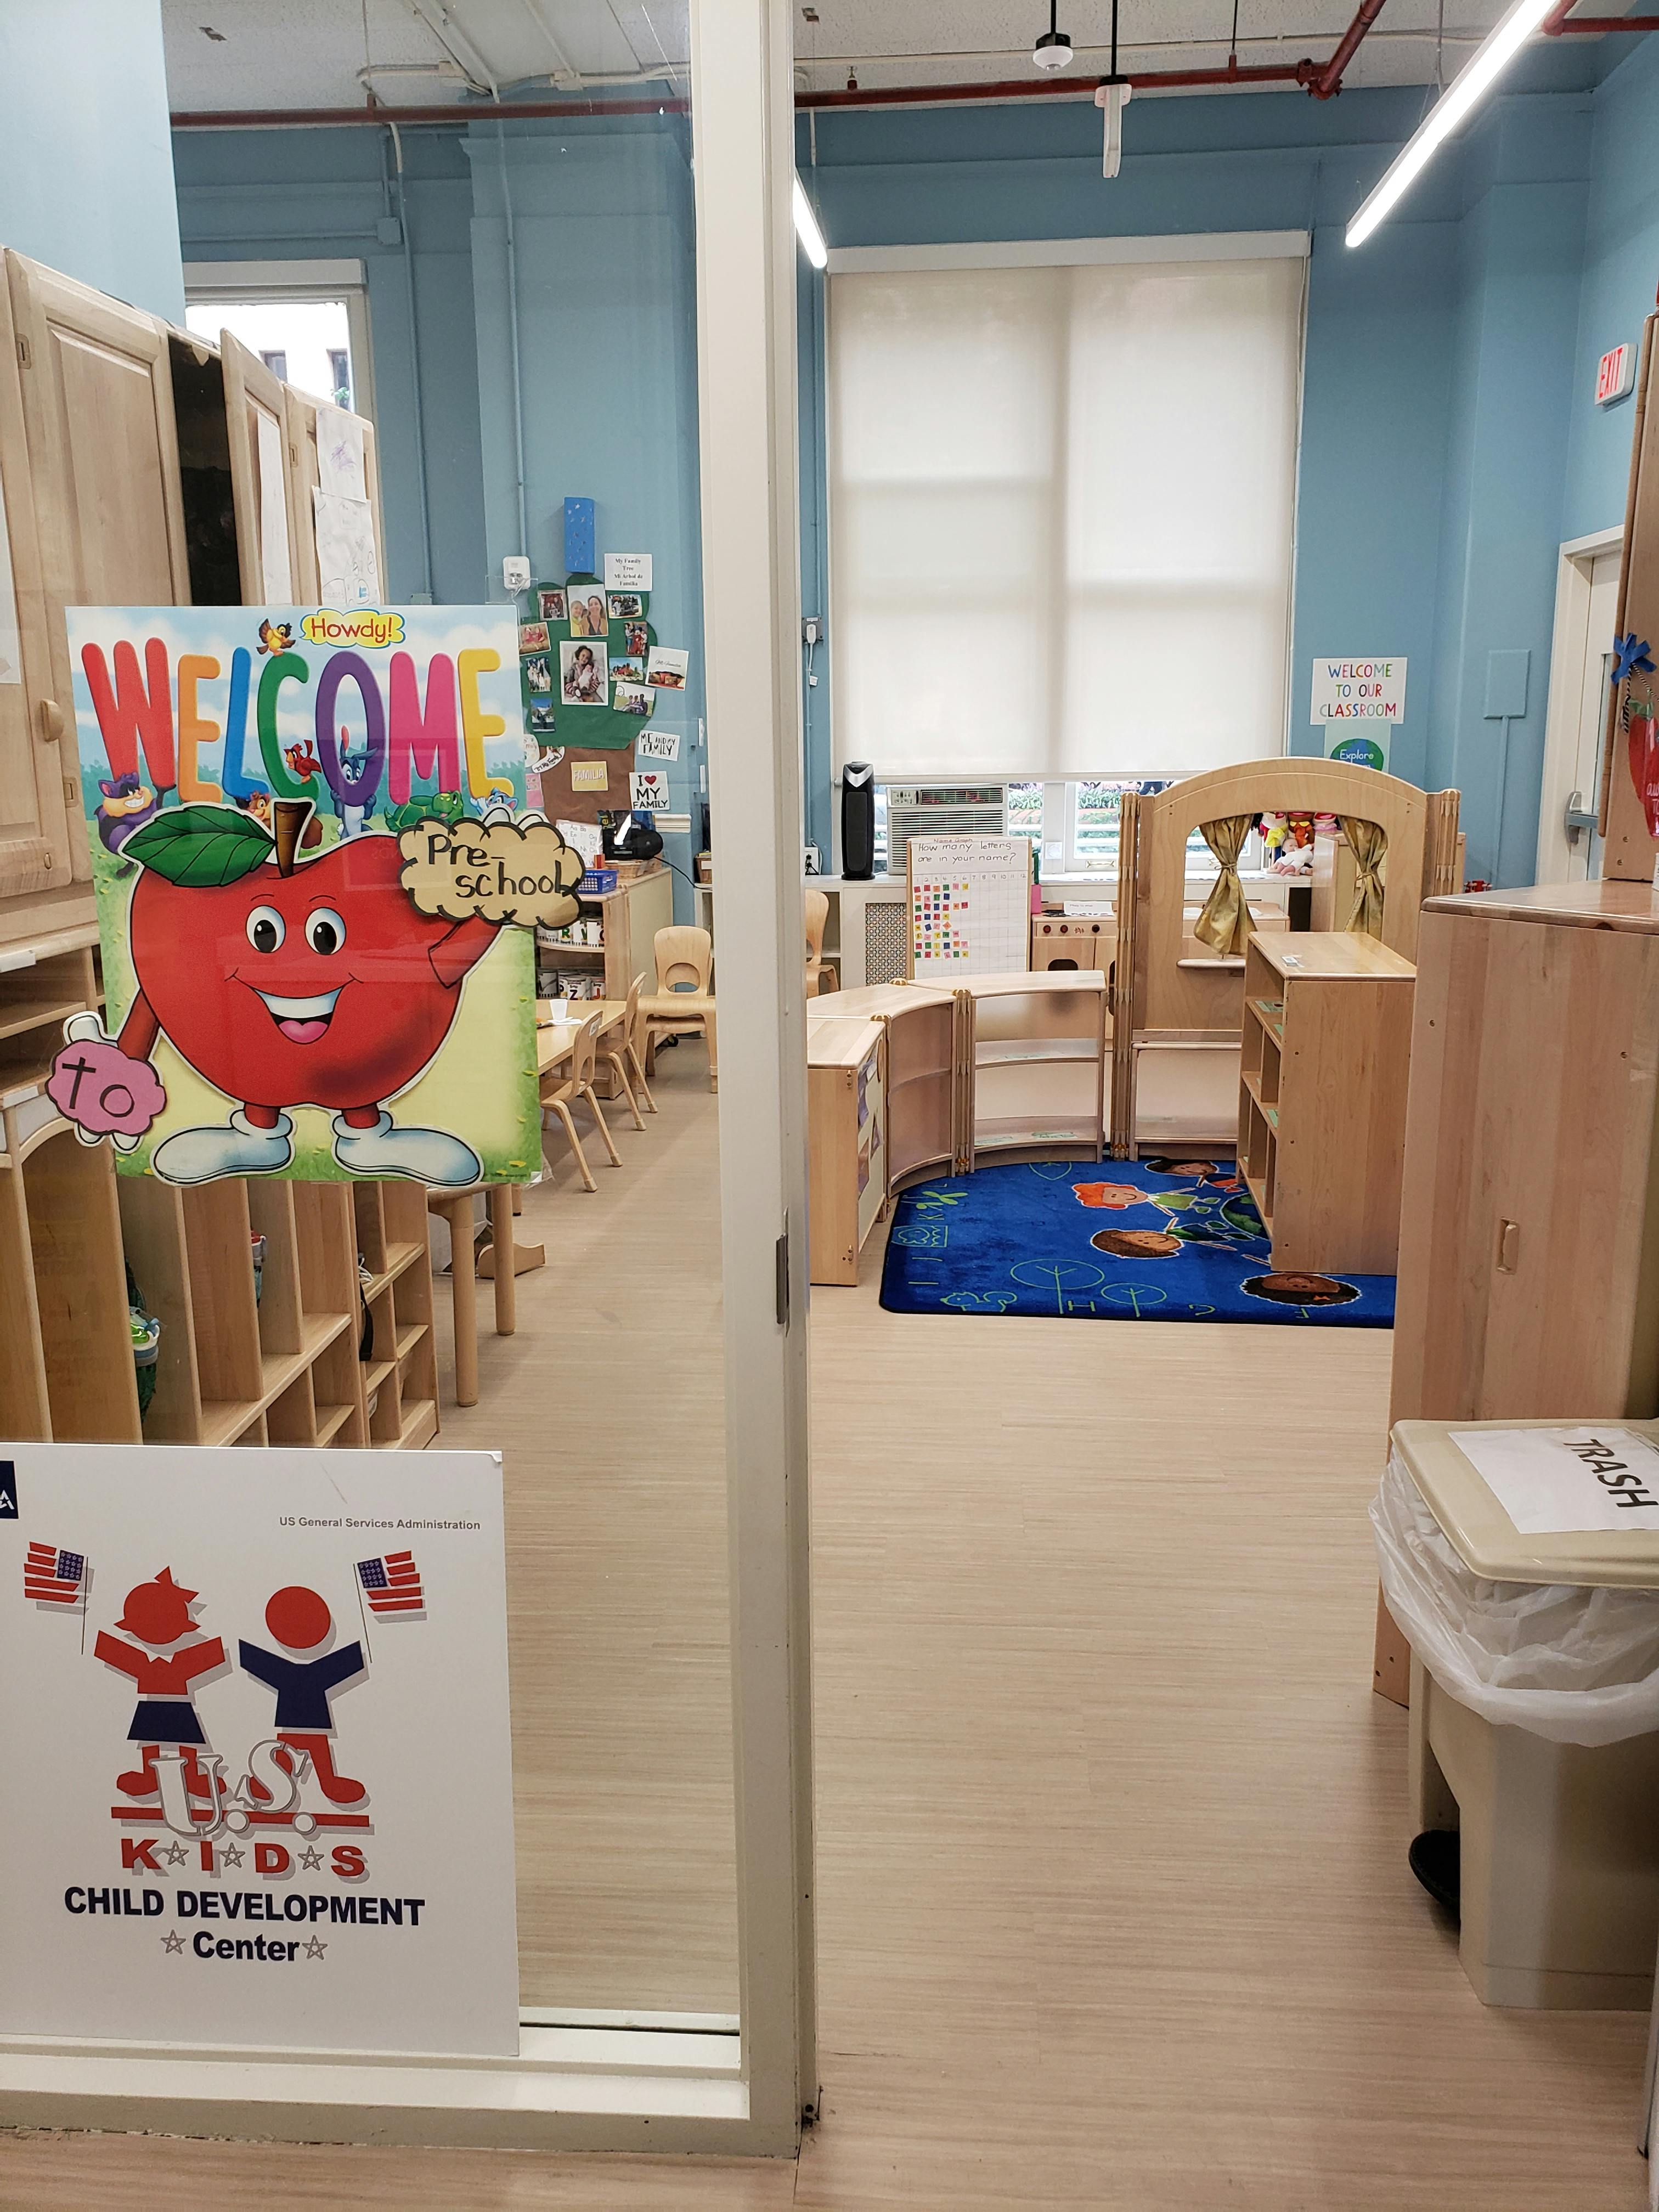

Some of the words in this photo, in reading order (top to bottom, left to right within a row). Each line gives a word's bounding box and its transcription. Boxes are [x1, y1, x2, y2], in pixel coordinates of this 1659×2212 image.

[1599, 347, 1623, 398] EXIT
[311, 616, 394, 644] Howdy!
[1328, 663, 1393, 678] WELCOME
[1335, 684, 1351, 697] TO
[1358, 684, 1382, 697] OUR
[1319, 703, 1397, 718] CLASSROOM
[81, 637, 515, 805] WELCOME
[1339, 748, 1374, 764] Explore
[637, 775, 644, 787] I
[636, 787, 661, 800] MY
[633, 799, 668, 810] FAMILY
[427, 833, 506, 867] Pre-
[918, 843, 938, 852] How
[942, 843, 973, 853] many
[980, 841, 1012, 850] letters
[952, 855, 974, 865] your
[979, 852, 1017, 864] name?
[455, 860, 562, 899] school
[569, 989, 578, 1000] Z
[61, 1057, 135, 1118] to
[1067, 1300, 1096, 1312] H
[1563, 1438, 1659, 1508] TRASH
[280, 1516, 296, 1526] US
[298, 1517, 342, 1527] General
[345, 1518, 394, 1529] Services
[396, 1519, 481, 1530] Administration
[64, 1886, 165, 1917] CHILD
[176, 1891, 426, 1926] DEVELOPMENT
[193, 1931, 301, 1962] Center
